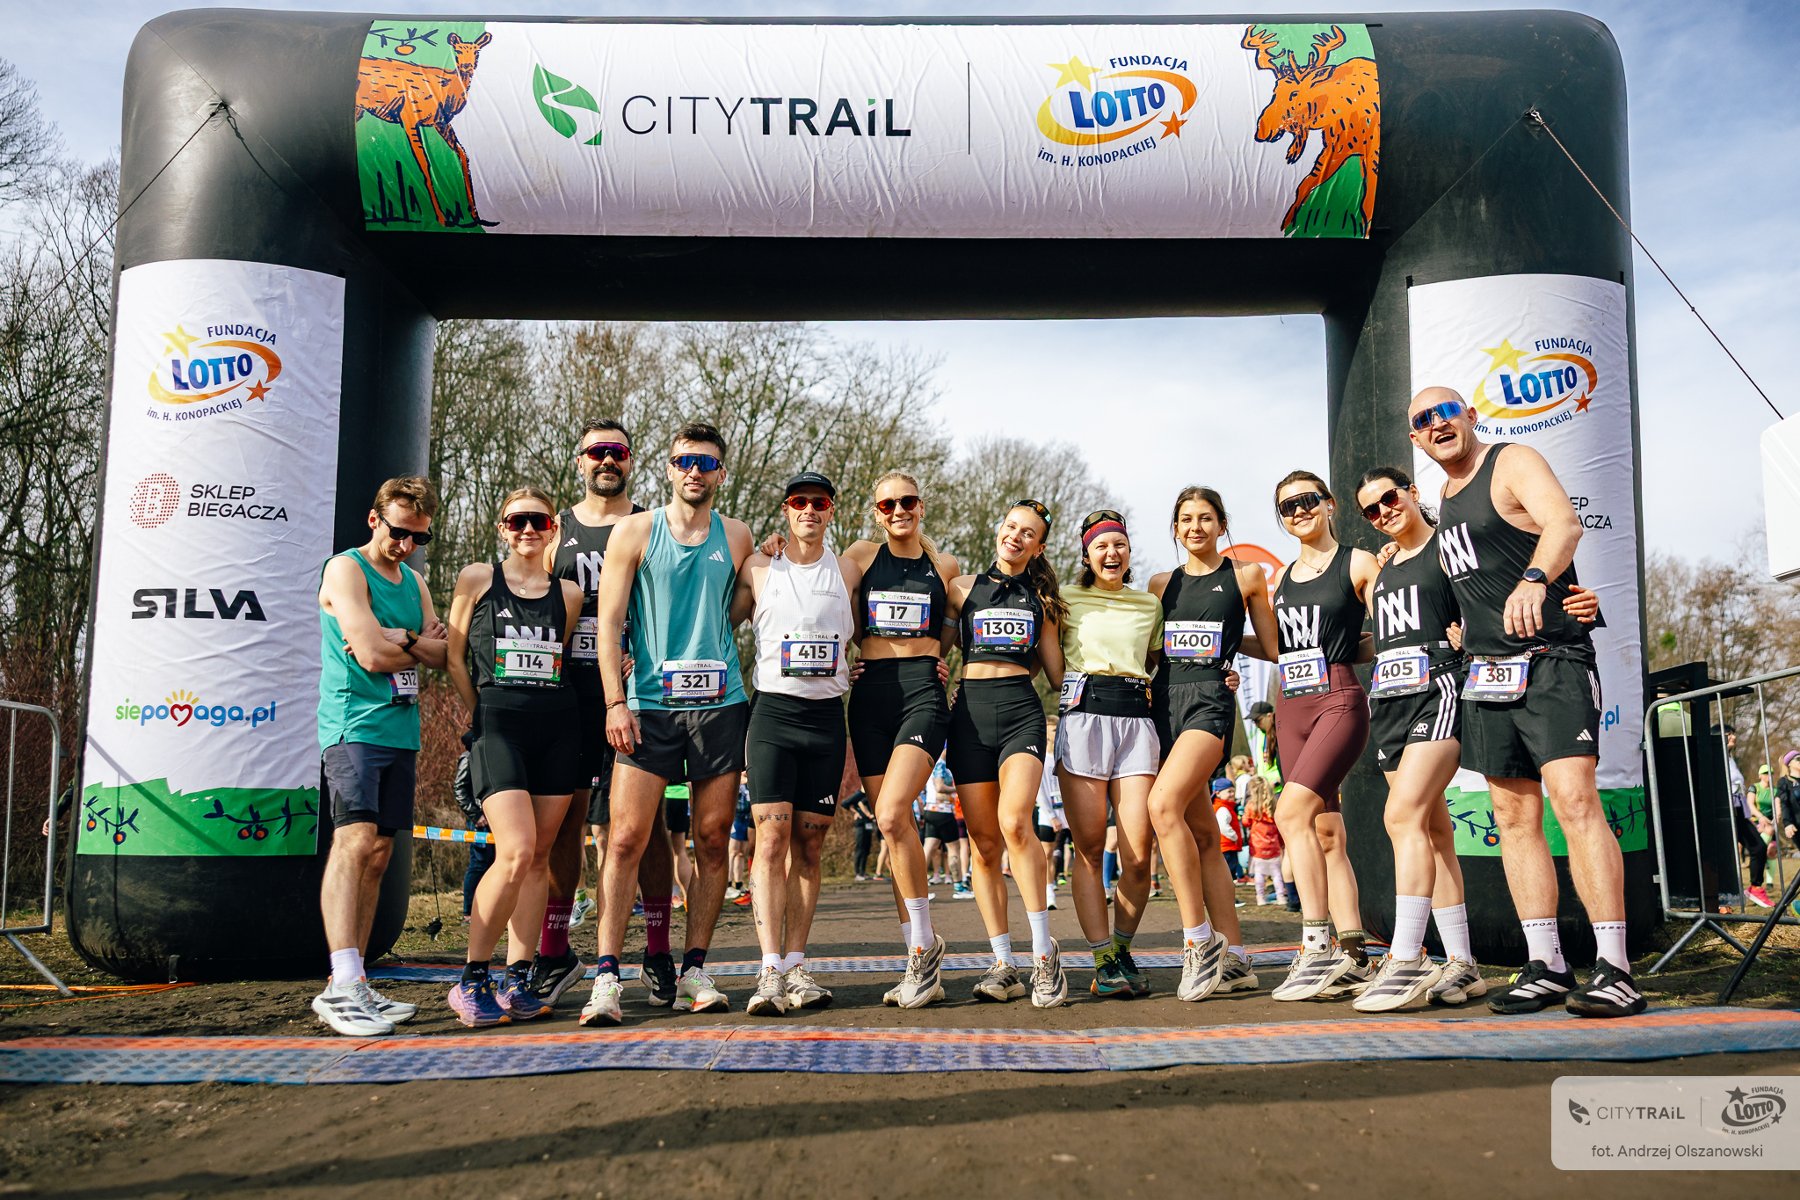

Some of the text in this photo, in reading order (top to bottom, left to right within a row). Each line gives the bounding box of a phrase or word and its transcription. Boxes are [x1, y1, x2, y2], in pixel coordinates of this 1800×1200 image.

[1110, 55, 1189, 72] FUNDACJA
[1067, 80, 1166, 129] LOTTO
[1037, 135, 1158, 168] im. H. KONOPACKIEJ
[207, 324, 277, 345] FUNDACJA
[1534, 336, 1594, 356] FUNDACJA
[171, 352, 253, 391] LOTTO
[1499, 365, 1578, 406] LOTTO
[146, 398, 243, 421] im. H. KONOPACKIEJ
[1474, 410, 1573, 436] im. H. KONOPACKIEJ
[190, 483, 256, 501] SKLEP
[187, 502, 289, 523] BIEGACZA
[132, 587, 267, 621] SILVA
[888, 605, 908, 620] 17
[983, 621, 1025, 636] 1303
[1172, 634, 1212, 648] 1400
[516, 653, 544, 669] 114
[798, 644, 828, 660] 415
[398, 671, 417, 686] 312
[1287, 663, 1314, 681] 522
[1381, 661, 1414, 679] 405
[1485, 667, 1512, 683] 381
[680, 674, 710, 689] 321
